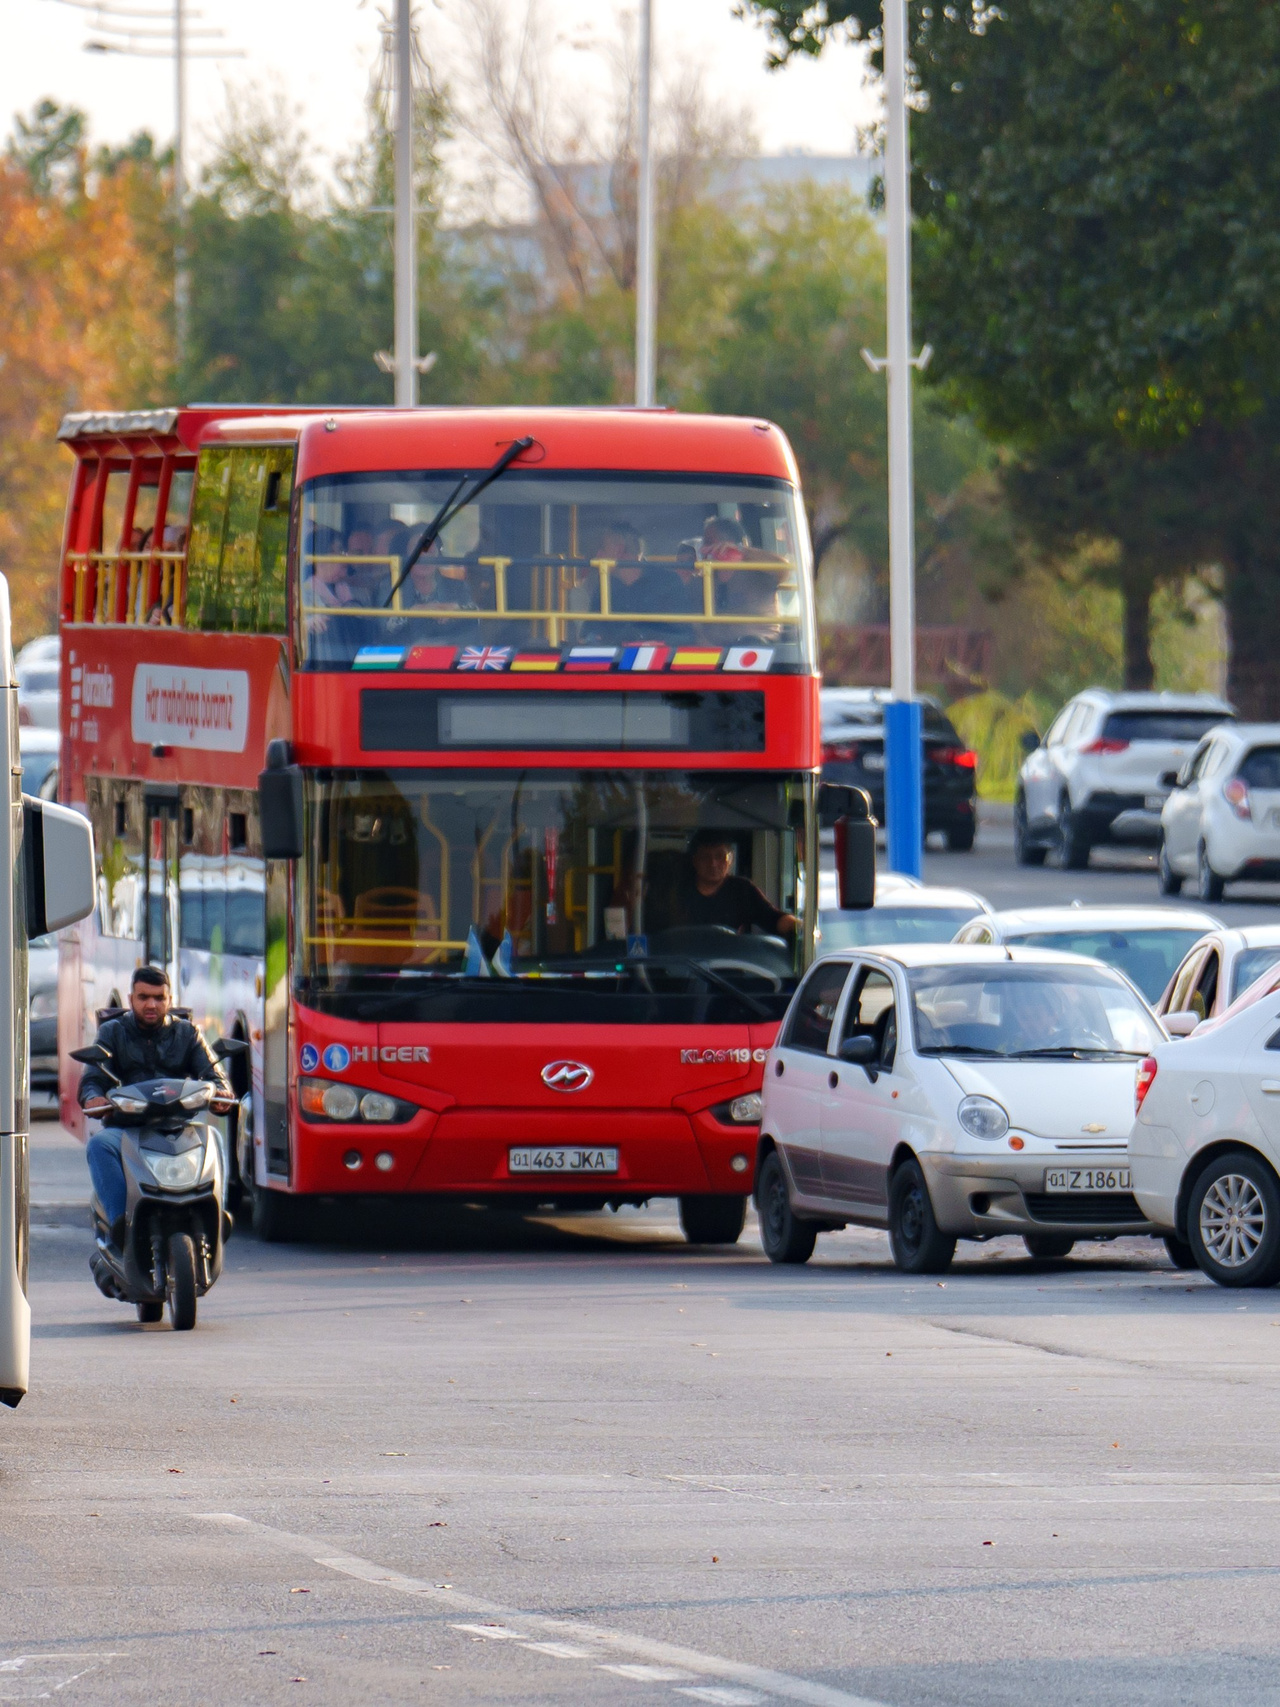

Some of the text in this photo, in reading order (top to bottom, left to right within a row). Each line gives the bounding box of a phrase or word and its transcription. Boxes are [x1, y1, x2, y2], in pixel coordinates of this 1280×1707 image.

[352, 1045, 430, 1063] HIGER
[513, 1153, 529, 1167] 01
[533, 1151, 565, 1169] 463
[570, 1151, 605, 1169] JKA
[1051, 1171, 1134, 1189] 01 Z 186 U
